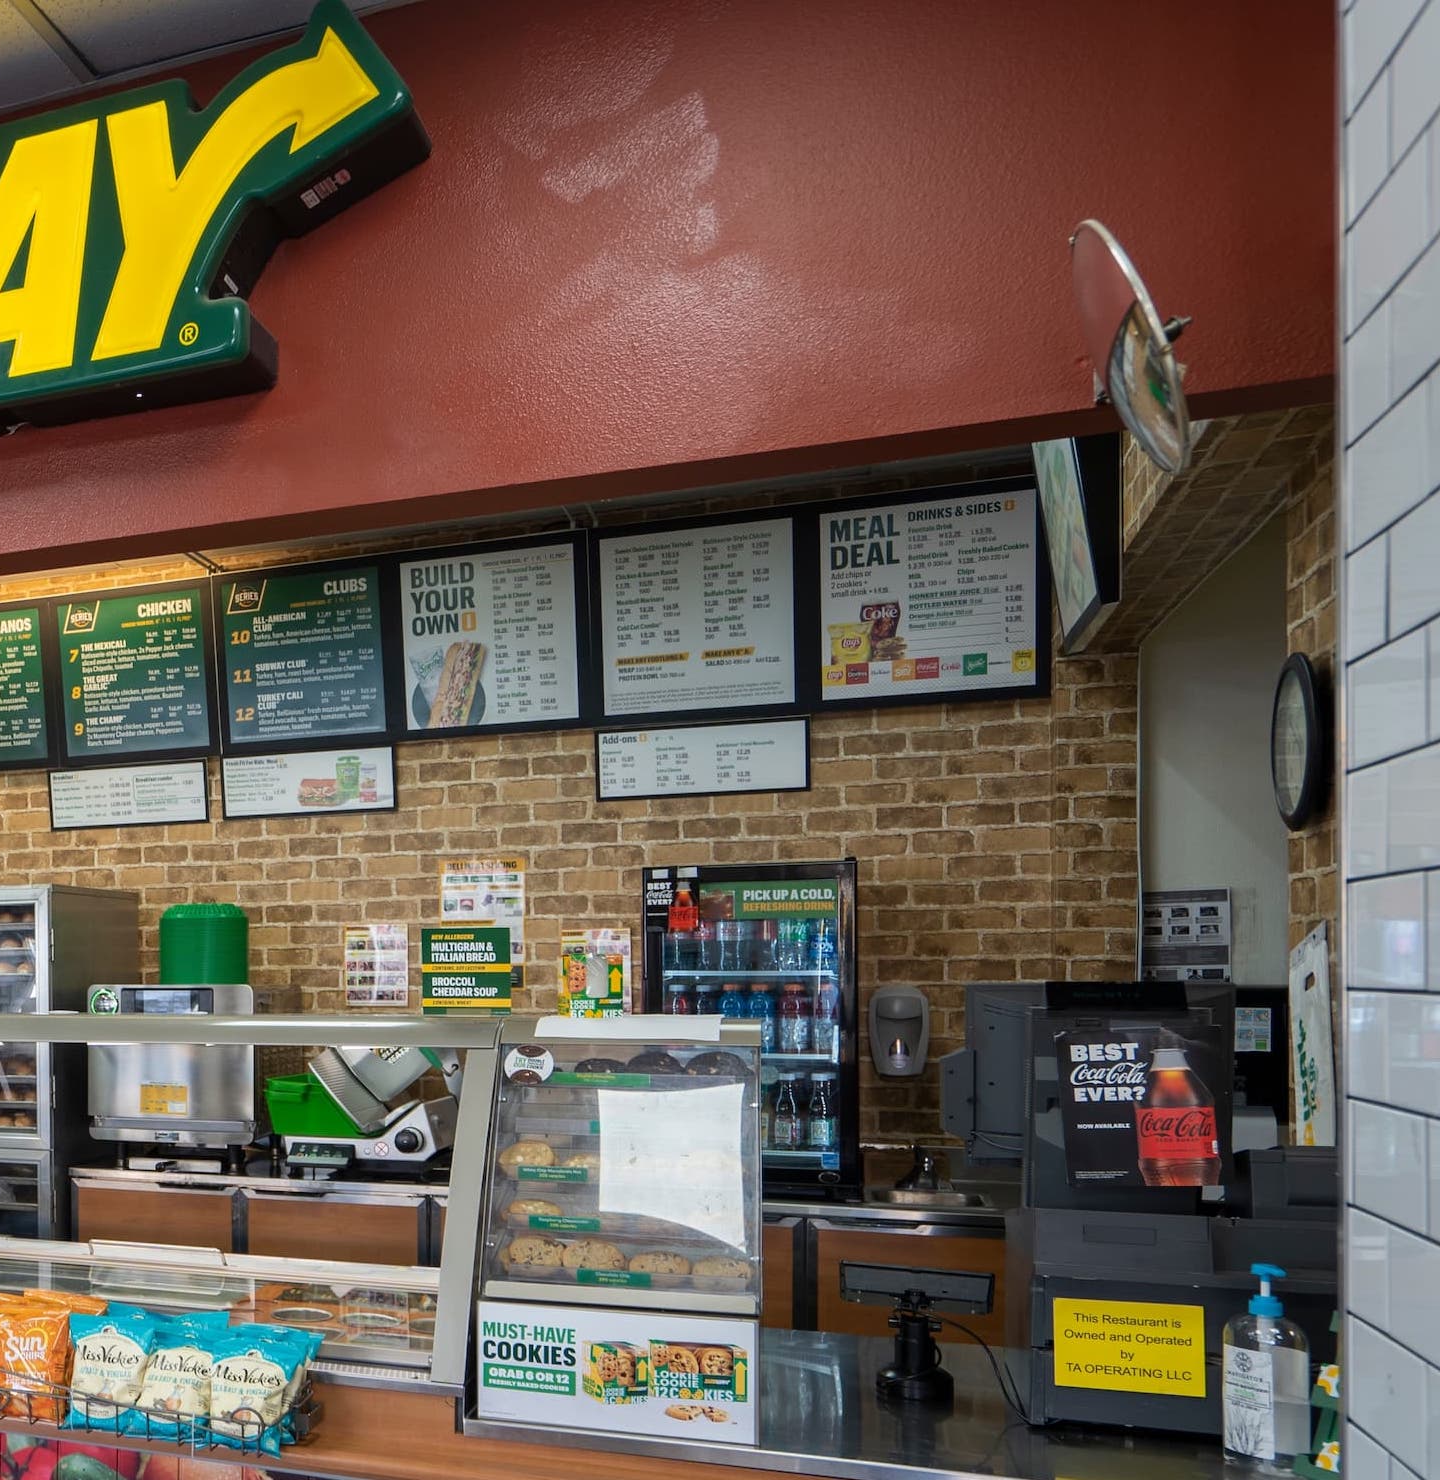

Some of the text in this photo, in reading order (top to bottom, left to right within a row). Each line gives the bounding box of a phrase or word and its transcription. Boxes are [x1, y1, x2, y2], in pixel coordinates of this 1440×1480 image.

[908, 501, 1002, 522] DRINKS & SIDES
[830, 513, 900, 543] MEAL
[831, 540, 900, 570] DEAL
[410, 562, 475, 589] BUILD
[845, 570, 863, 581] chips
[323, 577, 368, 596] CLUBS
[137, 598, 192, 618] CHICKEN
[410, 586, 475, 614] YOUR
[862, 605, 898, 621] Coke
[231, 630, 251, 645] 10
[253, 611, 306, 625] ALL-AMERICAN
[254, 623, 273, 633] CLUB
[412, 613, 459, 637] OWN
[69, 649, 79, 663] 7
[81, 643, 93, 652] THE
[233, 669, 252, 684] 11
[255, 661, 285, 672] SUBWAY
[287, 659, 307, 669] CLUB
[71, 686, 82, 699] 8
[83, 676, 95, 685] THE
[235, 707, 255, 722] 12
[257, 692, 285, 702] TURKEY
[257, 701, 276, 710] CLUB
[74, 723, 84, 735] 9
[86, 717, 98, 726] THE
[602, 735, 638, 745] Add-ons
[647, 882, 672, 890] BEST
[743, 888, 836, 901] PICK UP A COLD,
[647, 898, 673, 906] EVER?
[743, 901, 835, 912] REFRESHING DRINK
[431, 942, 494, 952] MULTIGRAIN &
[431, 952, 496, 962] ITALIAN BREAD
[431, 977, 476, 987] BROCCOLI
[432, 987, 498, 997] CHEDDAR SOUP
[1070, 1042, 1139, 1063] BEST
[1070, 1062, 1149, 1086] Coca-Cola
[1074, 1086, 1146, 1103] EVER?
[1094, 1122, 1131, 1130] AVAILABLE
[1140, 1110, 1212, 1138] Coca-Cola
[1073, 1313, 1182, 1329] This Restaurant is
[483, 1321, 576, 1345] MUST-HAVE
[1064, 1329, 1192, 1347] Owned and Operated
[4, 1333, 48, 1362] Sun
[483, 1340, 576, 1367] COOKIES
[1120, 1350, 1135, 1361] by
[242, 1368, 282, 1390] Vickie's
[489, 1367, 570, 1384] GRAB 6 OR 12
[654, 1370, 699, 1380] LOOKIE
[1066, 1362, 1192, 1381] TA OPERATING LLC
[517, 1381, 539, 1389] BAKED
[654, 1378, 699, 1388] LOOKIE
[655, 1387, 668, 1398] 12
